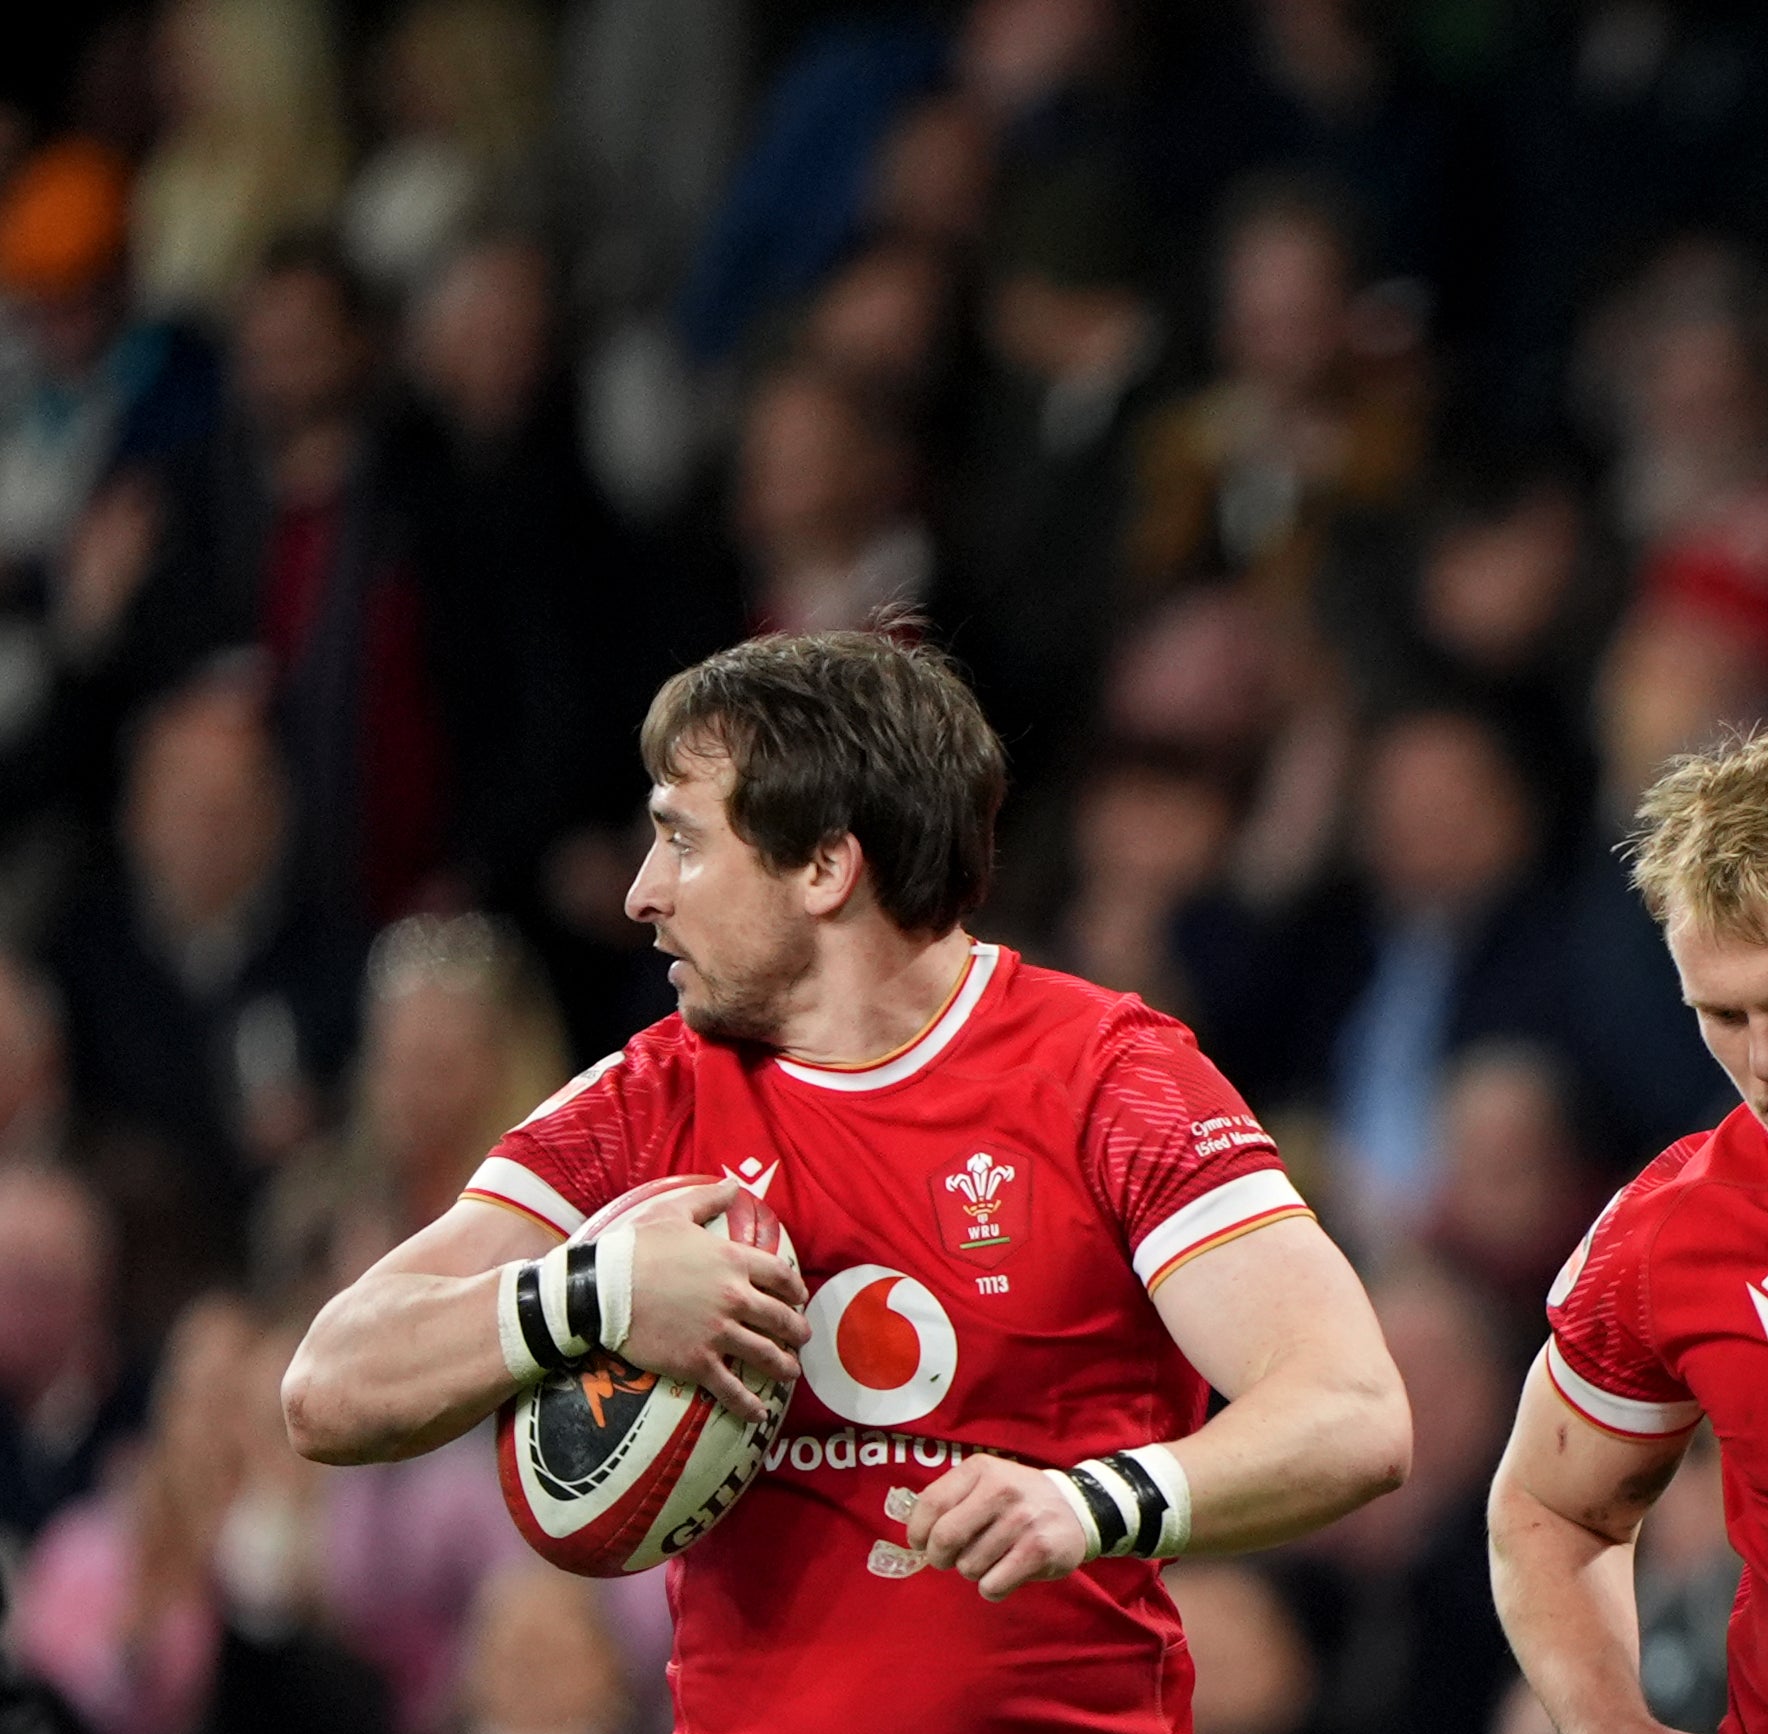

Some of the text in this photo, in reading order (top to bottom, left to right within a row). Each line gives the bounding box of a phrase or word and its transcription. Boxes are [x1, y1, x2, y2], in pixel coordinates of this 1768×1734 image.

[1191, 1116, 1232, 1137] Cymru
[1194, 1133, 1231, 1157] 15fed
[967, 1223, 1001, 1241] WRU
[975, 1274, 1009, 1295] 1113
